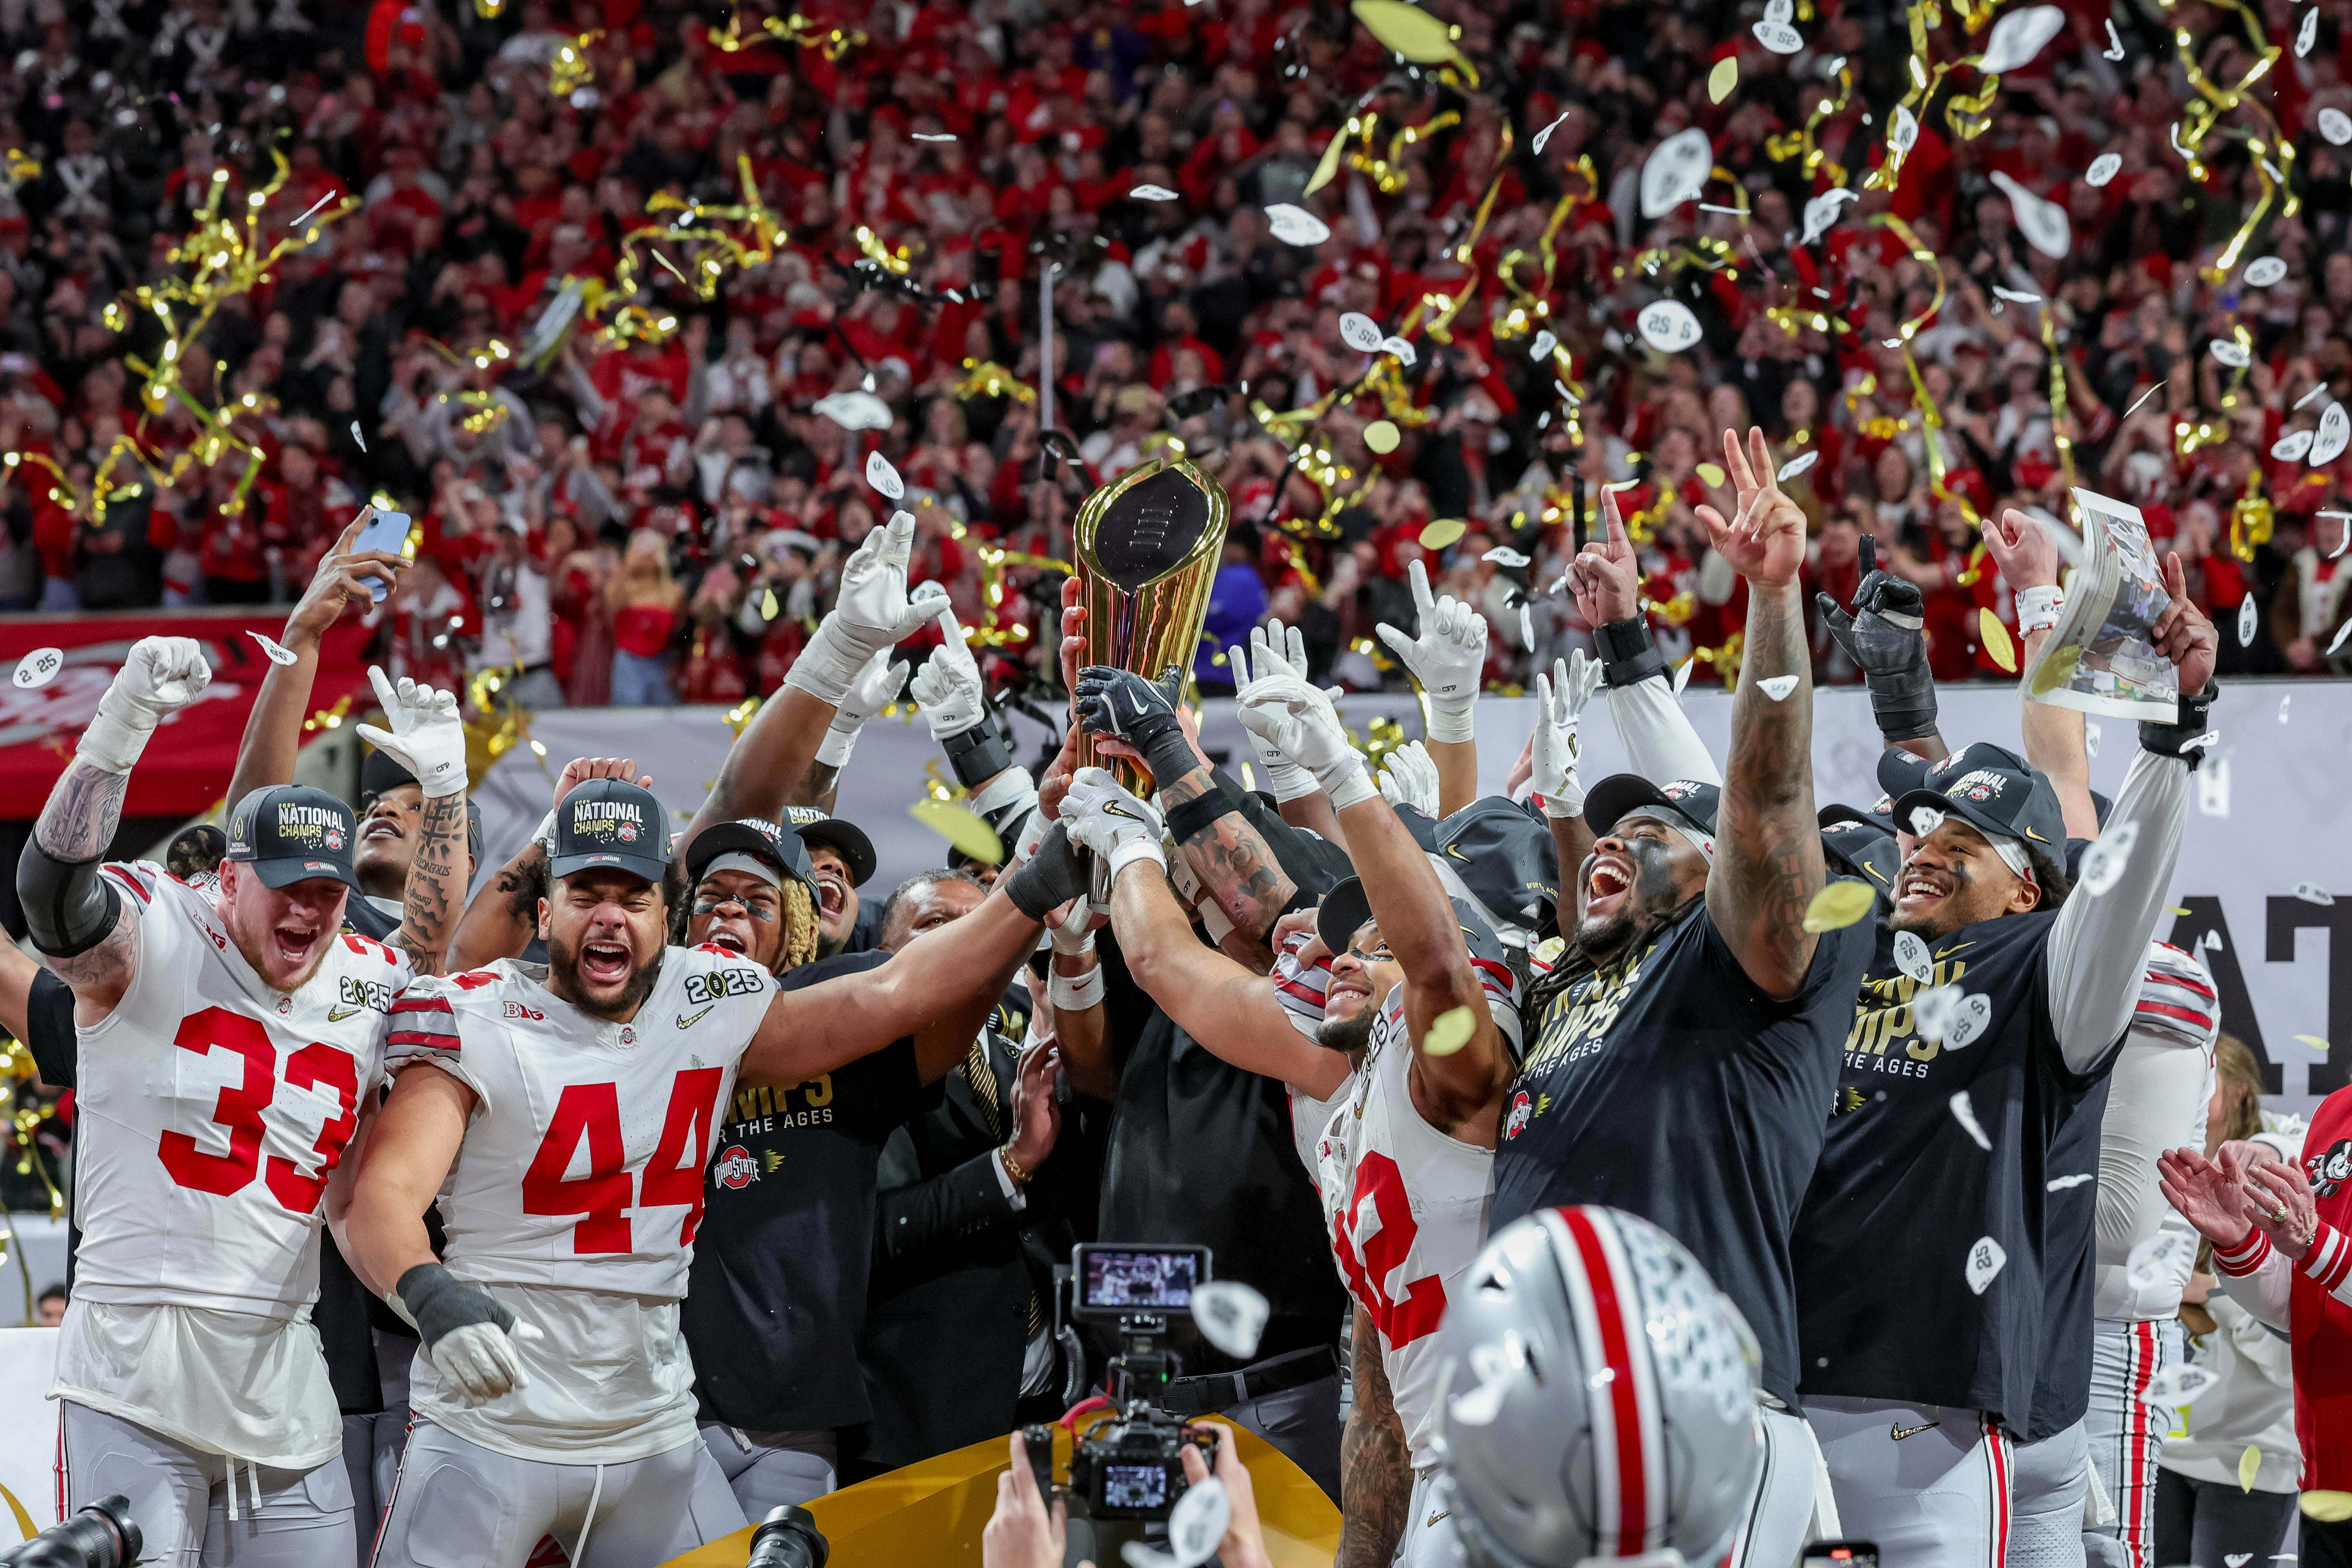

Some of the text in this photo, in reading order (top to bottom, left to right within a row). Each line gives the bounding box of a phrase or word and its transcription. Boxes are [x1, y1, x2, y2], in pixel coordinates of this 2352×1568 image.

[436, 762, 449, 772] CFP
[278, 807, 345, 832] NATIONAL
[574, 802, 643, 823] NATIONAL
[279, 824, 322, 837] CHAMPS
[574, 819, 615, 834] CHAMPS
[340, 976, 390, 1013] 2025
[685, 969, 764, 1005] 2025
[1528, 1061, 1555, 1081] THE
[1559, 1038, 1602, 1068] AGES
[1844, 1053, 1928, 1078] HE AGES
[158, 1005, 358, 1214] 33
[736, 1117, 773, 1138] THE
[784, 1109, 833, 1129] AGES
[523, 1067, 723, 1254] 44
